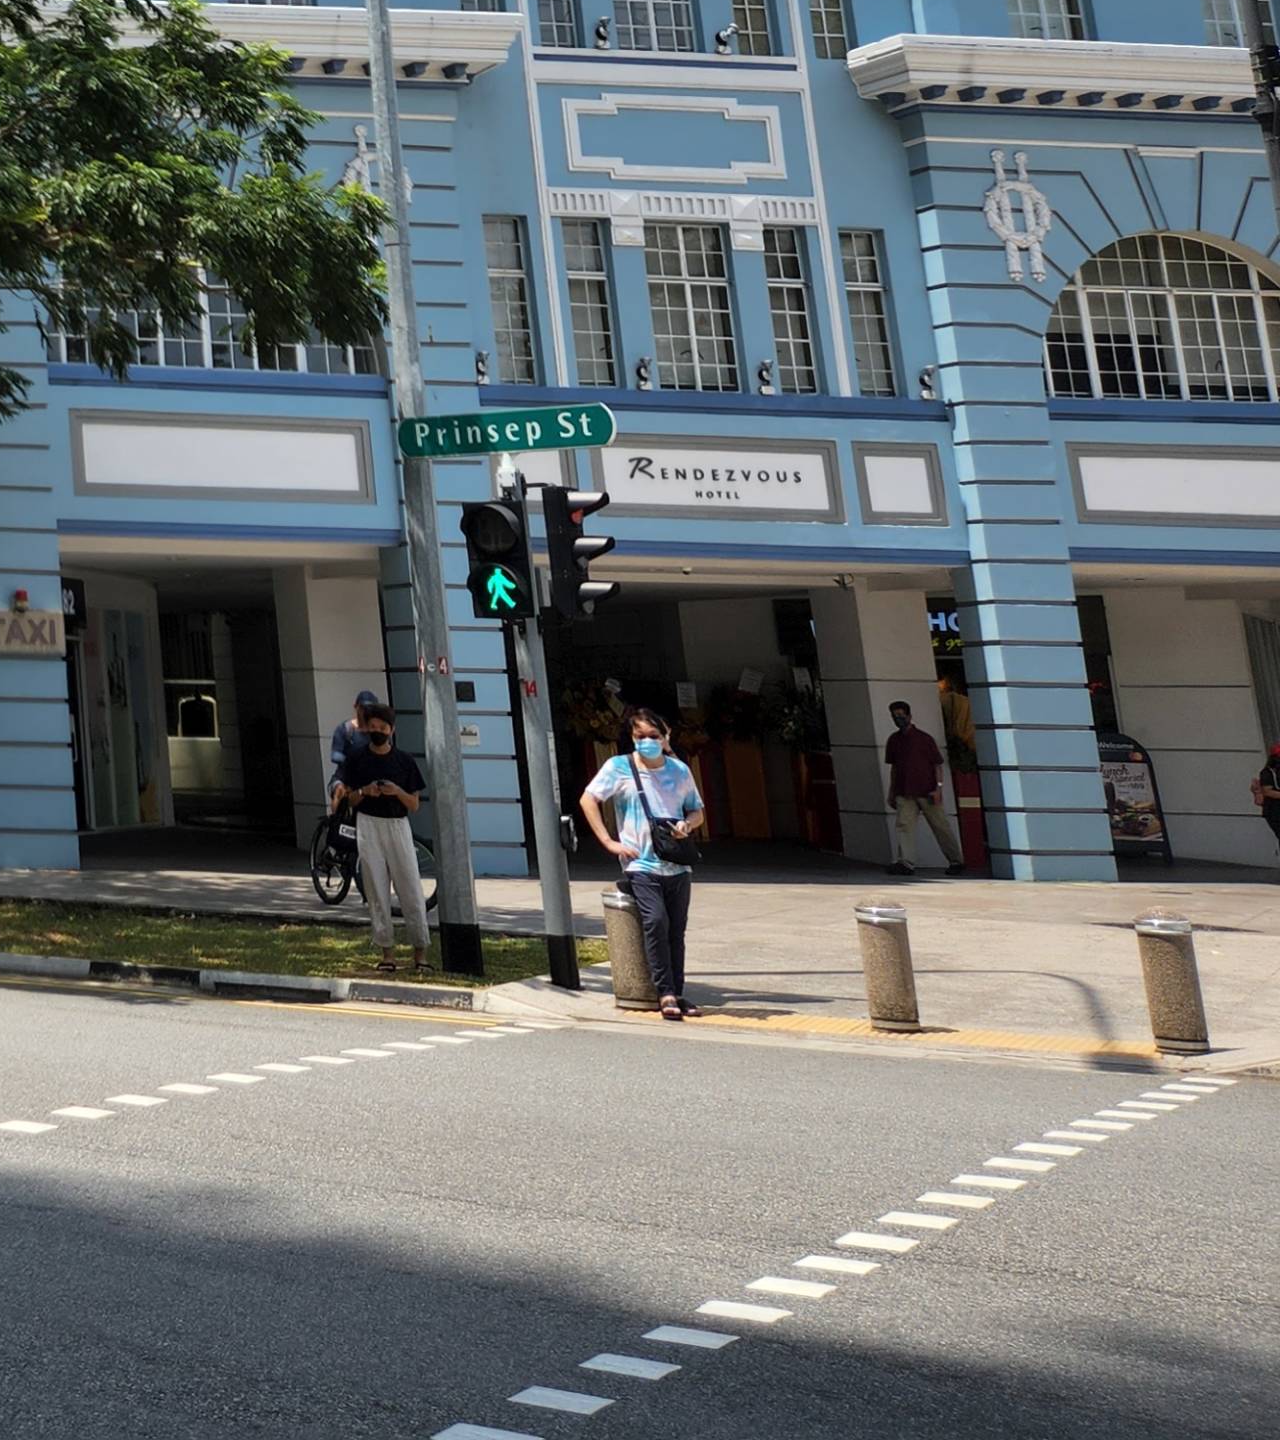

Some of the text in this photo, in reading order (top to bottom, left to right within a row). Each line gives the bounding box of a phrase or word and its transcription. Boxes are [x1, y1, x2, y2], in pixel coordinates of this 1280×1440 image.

[414, 412, 593, 447] Prinsep St
[627, 456, 802, 483] RENDEZVOUS
[695, 490, 740, 500] HOTEL
